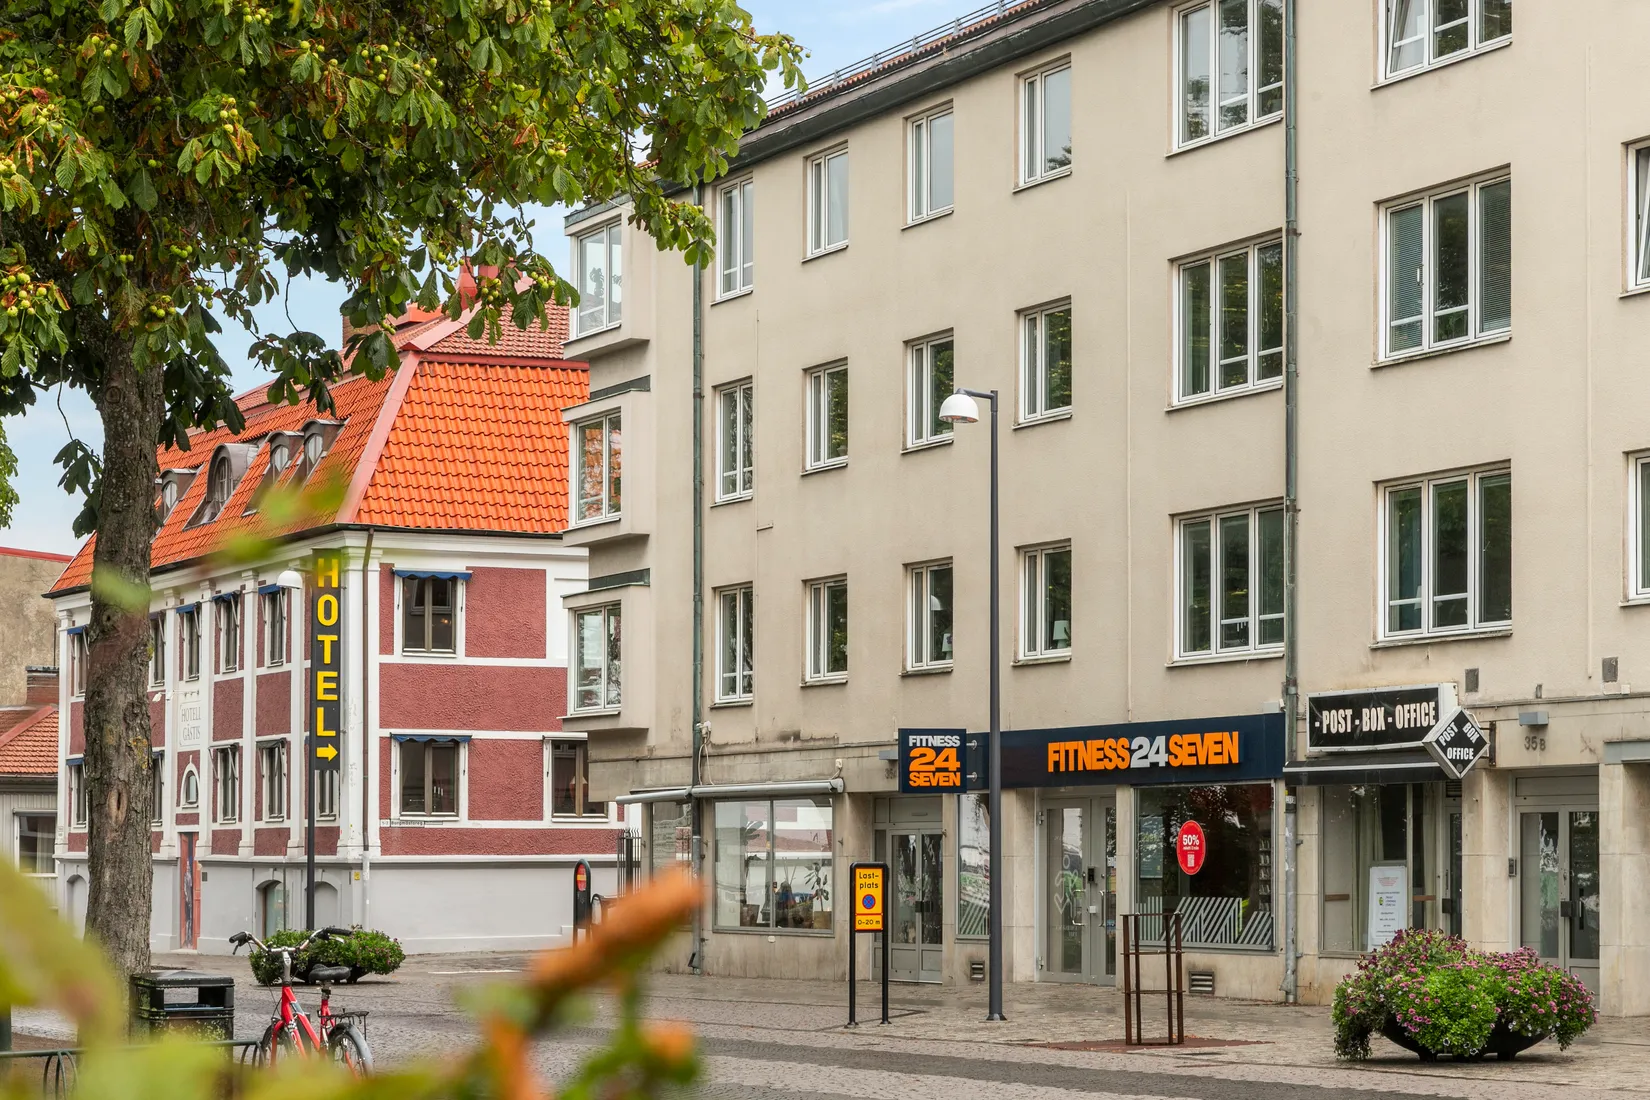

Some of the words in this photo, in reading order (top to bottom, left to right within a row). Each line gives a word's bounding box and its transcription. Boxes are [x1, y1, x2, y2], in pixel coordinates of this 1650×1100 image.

[316, 558, 339, 737] HOTEL
[1362, 706, 1386, 732] BOX
[1394, 701, 1436, 730] OFFICE
[908, 735, 961, 747] FITNESS
[1438, 721, 1459, 747] POST
[1462, 721, 1480, 744] BOX
[908, 747, 961, 772] 24
[1048, 731, 1240, 773] FITNESS24SEVEN
[1446, 747, 1475, 761] OFFICE
[908, 771, 961, 788] SEVEN
[1182, 834, 1200, 846] 50%
[858, 871, 880, 880] Last-
[859, 881, 879, 891] plats
